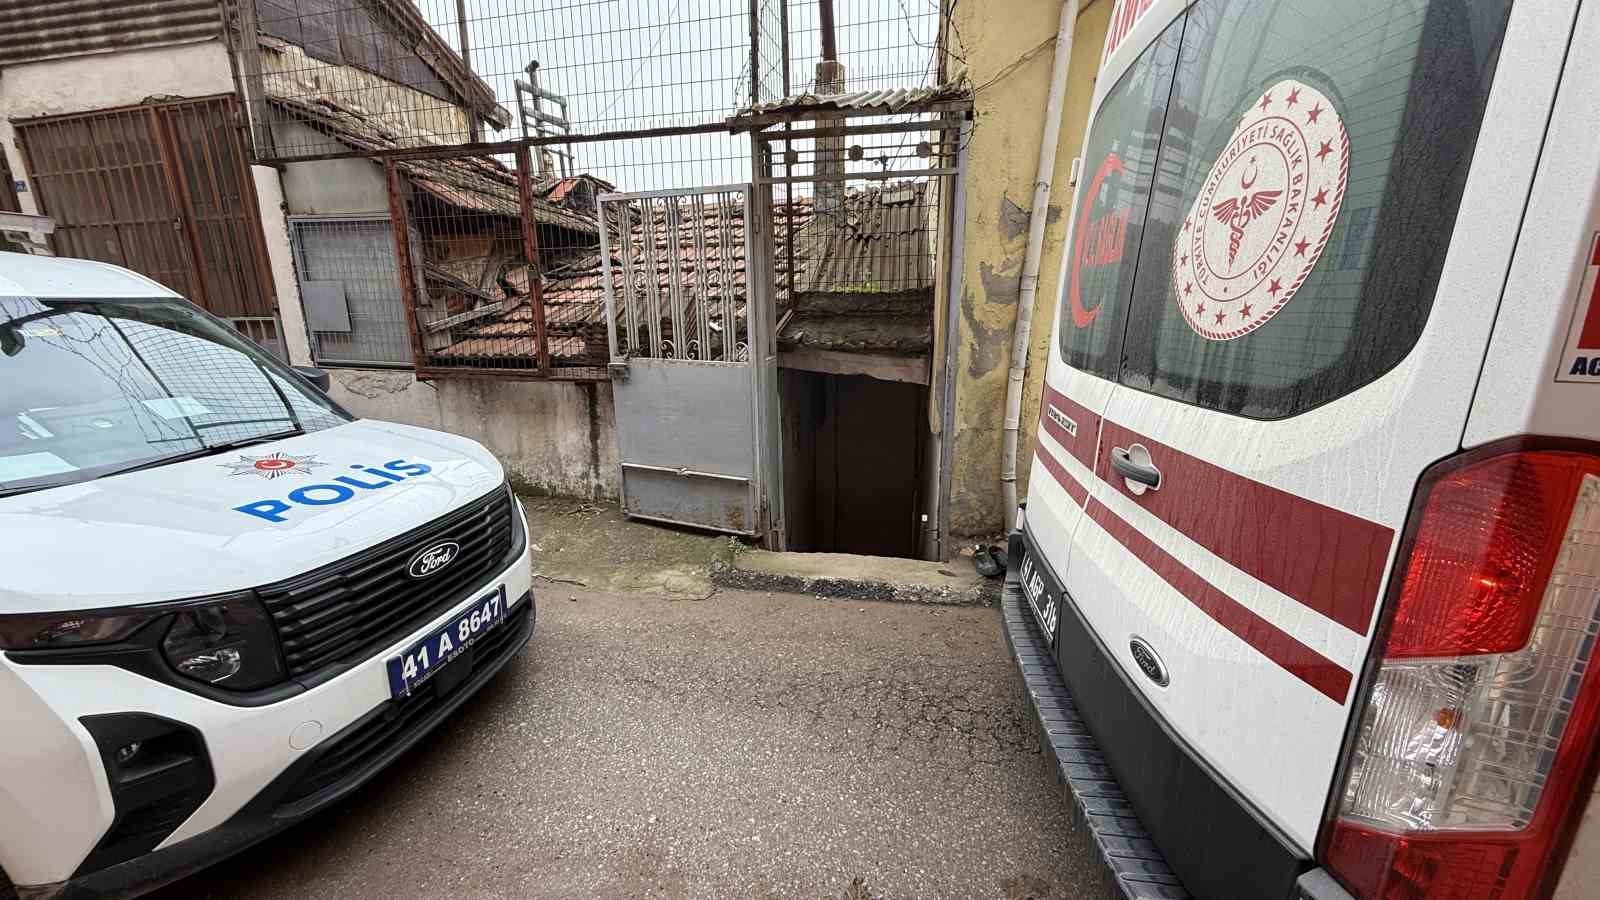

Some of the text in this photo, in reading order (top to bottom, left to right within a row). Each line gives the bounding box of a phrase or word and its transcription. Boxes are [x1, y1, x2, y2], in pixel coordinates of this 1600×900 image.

[1271, 126, 1303, 172] SAĞLIK
[421, 548, 450, 573] Ford
[402, 646, 430, 680] 41
[438, 632, 453, 658] A
[458, 595, 500, 642] 8647
